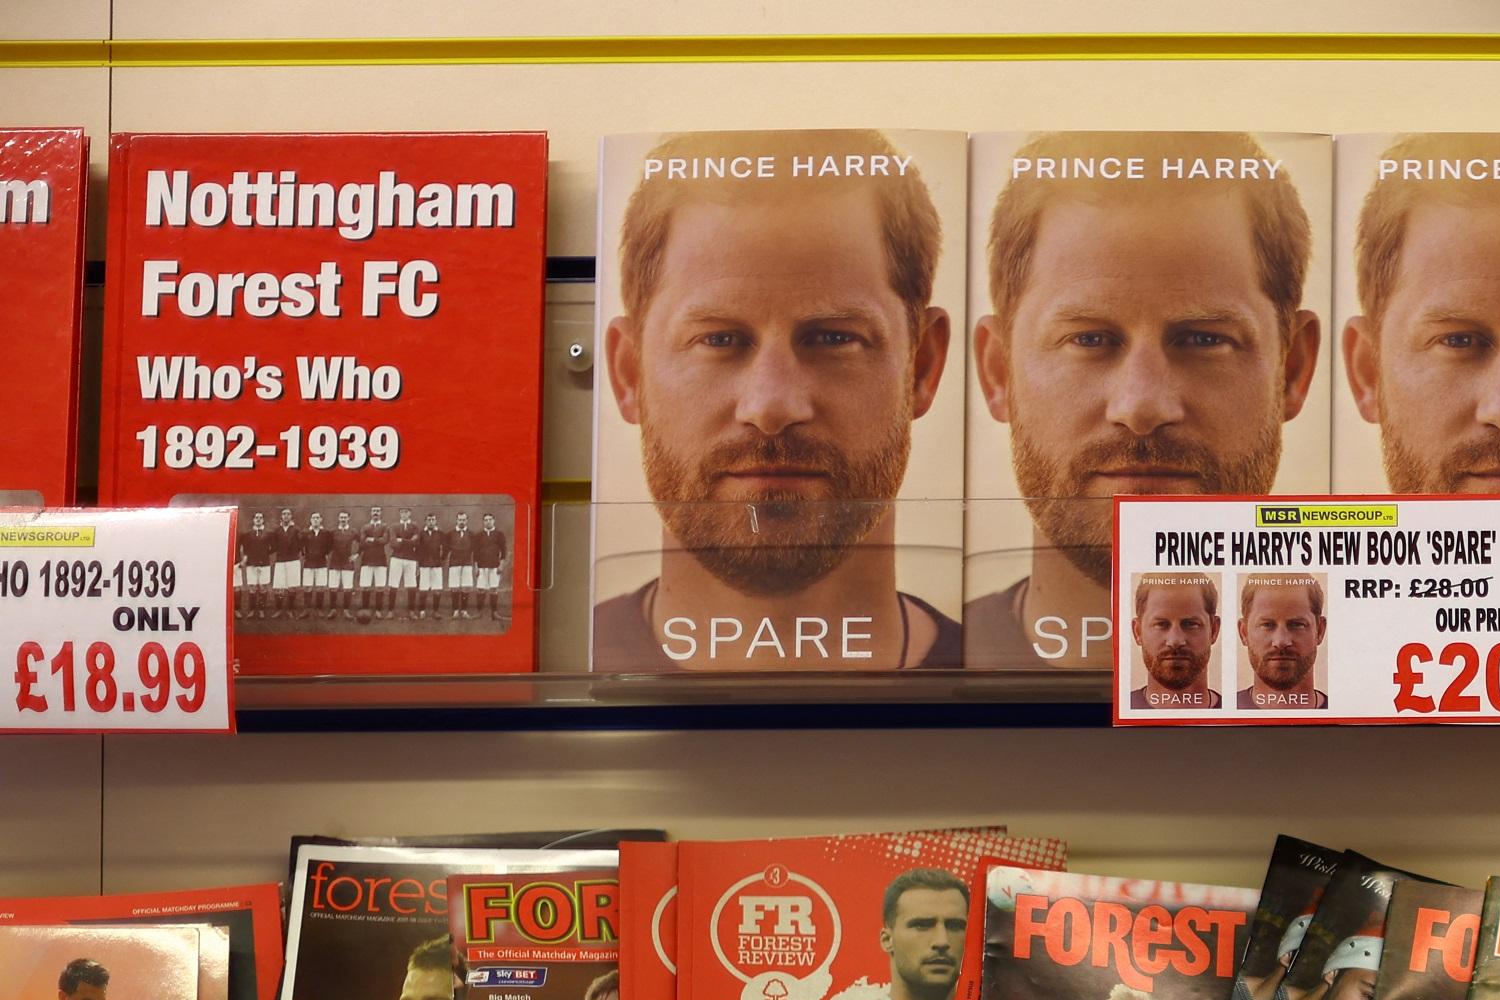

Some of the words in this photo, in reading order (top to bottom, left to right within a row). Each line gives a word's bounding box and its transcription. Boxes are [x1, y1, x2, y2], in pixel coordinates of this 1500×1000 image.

[644, 156, 775, 181] PRINCE
[792, 154, 914, 178] HARRY
[1013, 156, 1144, 180] PRINCE
[1162, 156, 1284, 181] HARRY
[145, 170, 514, 240] Nottingham
[141, 260, 342, 317] Forest
[361, 261, 440, 318] FC
[137, 356, 283, 400] Who's
[296, 357, 401, 400] Who
[136, 425, 400, 469] 1892-1939
[1264, 509, 1297, 522] MSR
[1302, 510, 1382, 522] NEWSGROUP
[0, 531, 80, 542] NEWSGROUP
[1155, 531, 1225, 566] PRINCE
[1231, 531, 1313, 566] HARRY'S
[1318, 531, 1362, 565] NEW
[1366, 530, 1420, 565] BOOK
[1426, 530, 1496, 564] 'SPARE'
[39, 560, 176, 598] 1892-1939
[1248, 578, 1283, 586] PRINCE
[1286, 578, 1317, 586] HARRY
[1344, 579, 1400, 598] RRP:
[1408, 577, 1490, 598] £28.00
[113, 606, 200, 631] ONLY
[1435, 608, 1471, 632] OUR
[661, 615, 875, 662] SPARE
[15, 641, 206, 713] £18.99
[1149, 693, 1203, 706] SPARE
[1256, 693, 1309, 706] SPARE
[310, 862, 448, 914] fores
[132, 907, 160, 915] OFFICIAL
[162, 905, 196, 913] MATCHDAY
[198, 901, 239, 910] PROGRAMME
[738, 896, 816, 935] FR
[478, 950, 494, 958] The
[497, 950, 530, 958] Official
[533, 950, 576, 960] Matchday
[580, 950, 619, 960] Magazin
[738, 936, 816, 951] FOREST
[738, 951, 816, 966] REVIEW
[496, 969, 512, 979] sky
[516, 970, 536, 979] BET
